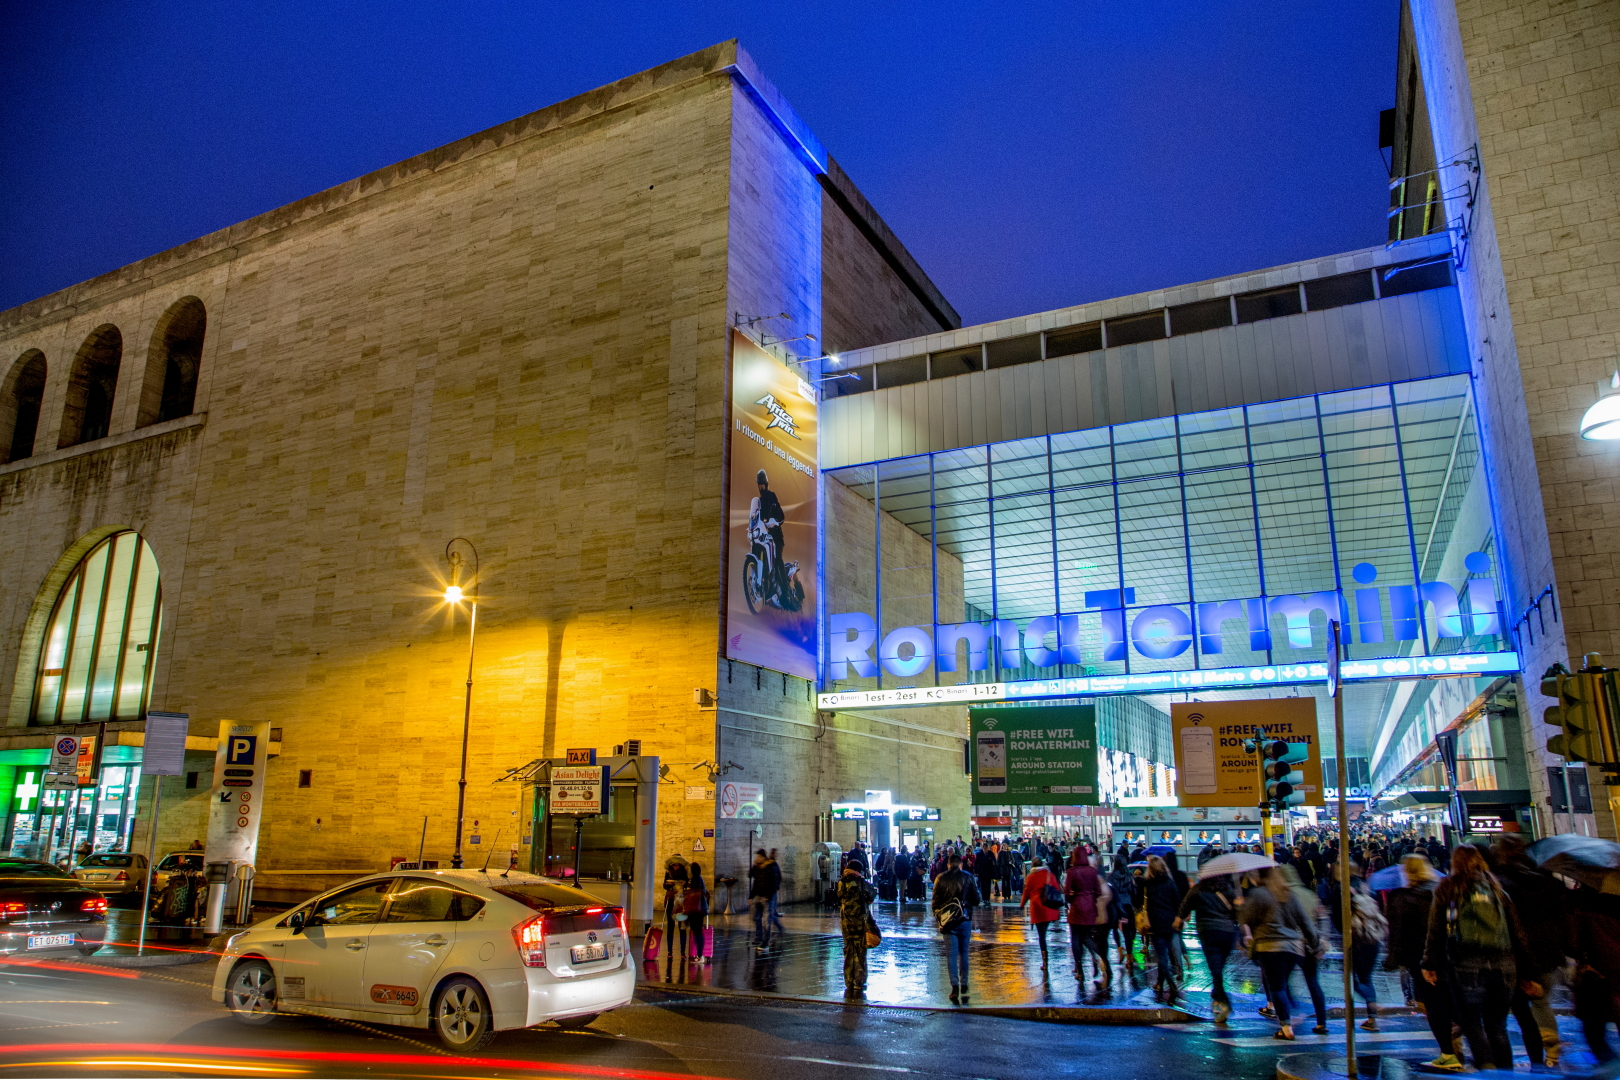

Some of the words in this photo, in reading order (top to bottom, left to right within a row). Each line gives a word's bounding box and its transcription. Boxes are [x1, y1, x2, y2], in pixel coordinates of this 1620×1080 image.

[754, 392, 800, 428] Africa
[766, 413, 802, 441] Twin
[736, 418, 741, 432] Il
[742, 424, 766, 447] ritorno
[766, 439, 773, 450] di
[774, 444, 786, 460] una
[787, 452, 814, 478] leggenda.
[1129, 676, 1171, 685] Aeroporto
[896, 692, 917, 700] 2est
[1261, 723, 1293, 734] WIFI
[1010, 729, 1044, 739] #FREE
[1047, 729, 1074, 738] WIFI
[232, 739, 250, 761] P
[1010, 740, 1090, 750] ROMATERMINI
[569, 752, 589, 762] TAXI
[554, 771, 574, 779] Asian
[576, 770, 600, 779] Delight
[396, 990, 416, 1002] 6645
